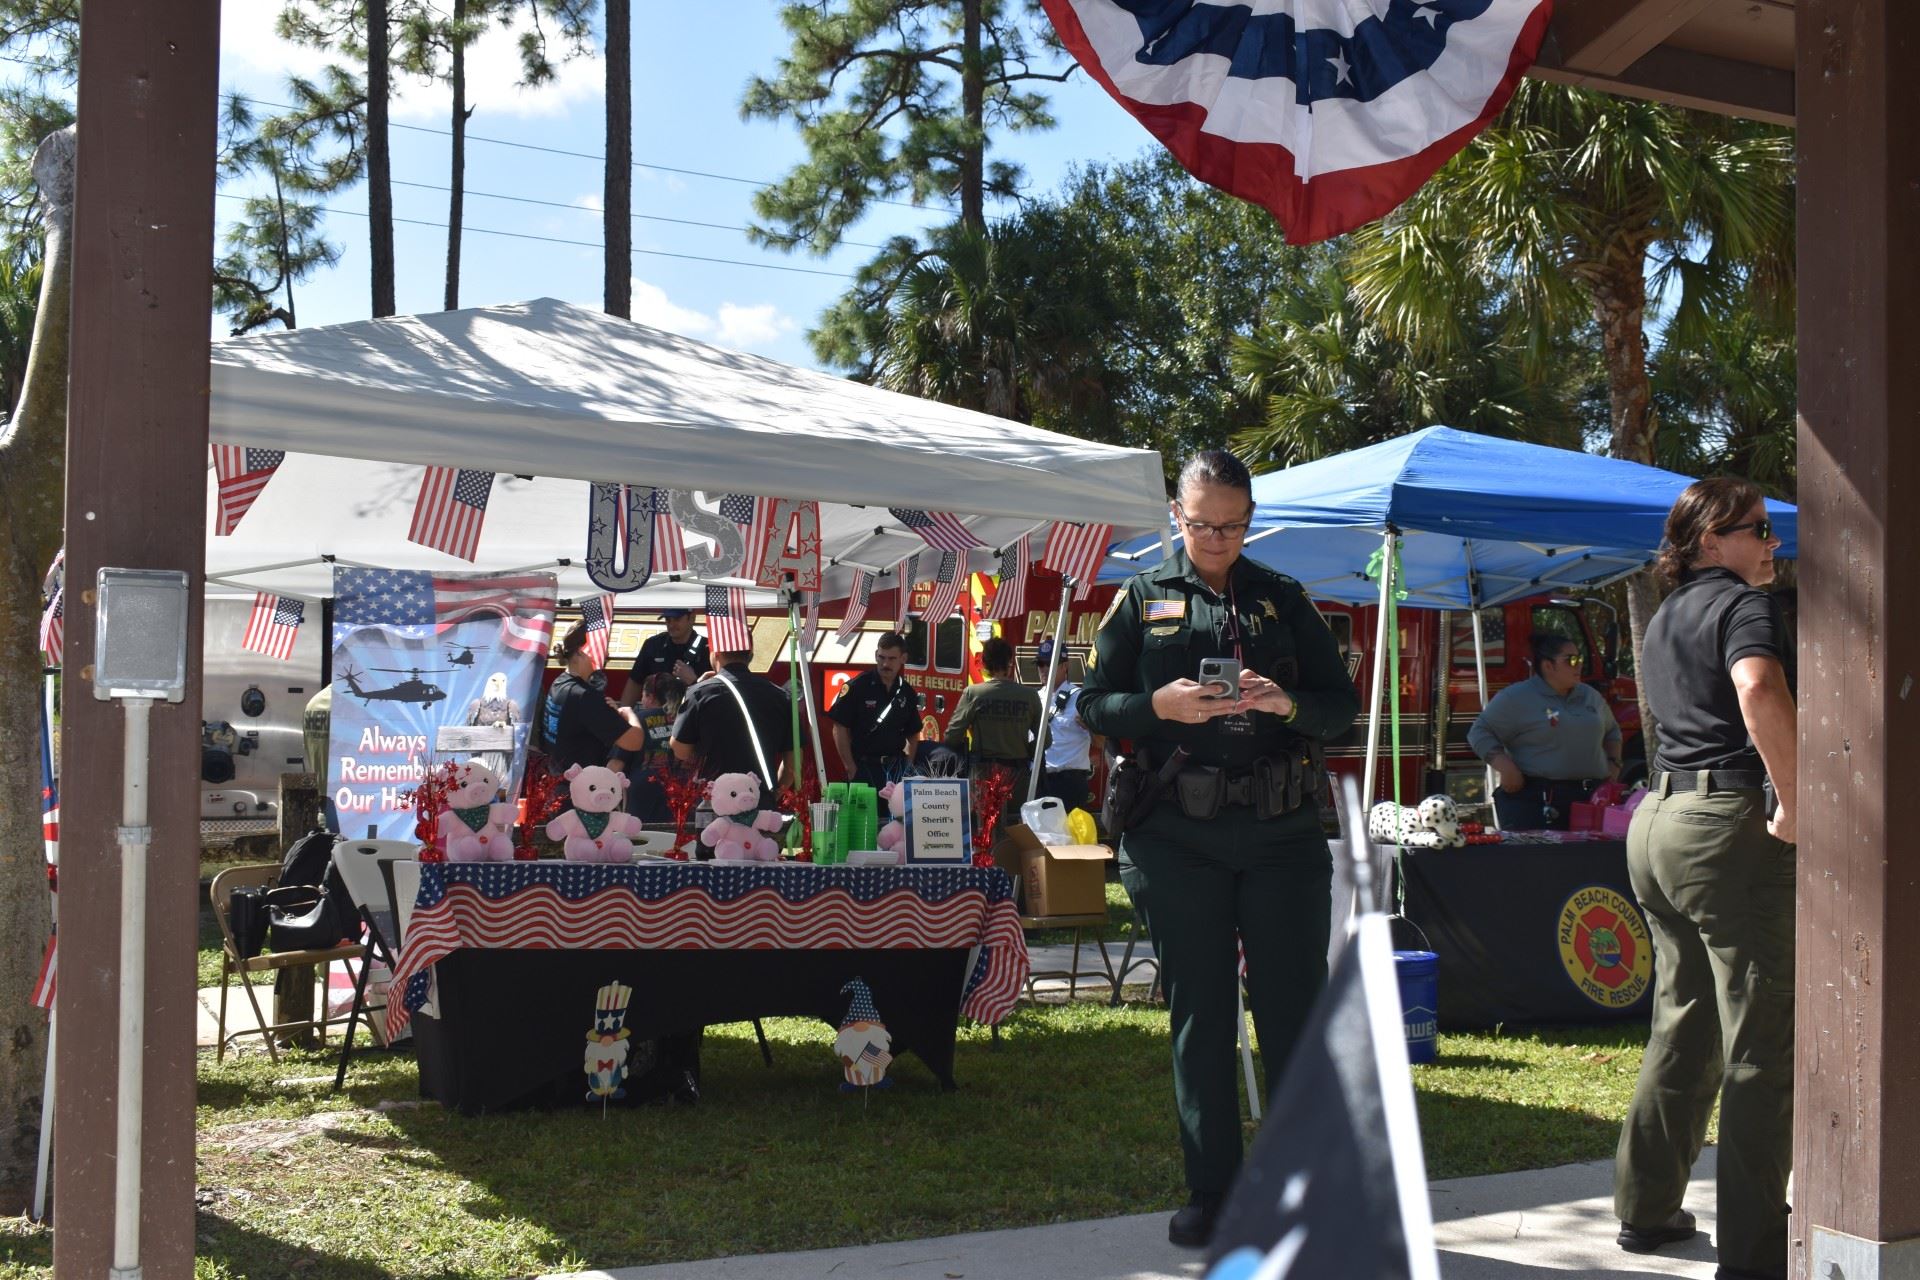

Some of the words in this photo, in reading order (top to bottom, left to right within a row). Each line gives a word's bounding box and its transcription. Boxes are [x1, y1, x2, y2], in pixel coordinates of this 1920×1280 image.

[586, 483, 822, 593] USA
[1024, 610, 1100, 645] PALM
[924, 676, 964, 692] RESCUE
[978, 699, 1029, 716] SHERIFF
[358, 725, 428, 761] Always
[335, 786, 374, 812] Our
[913, 788, 933, 796] Palm
[934, 788, 958, 796] Beach
[922, 802, 951, 811] County
[921, 816, 954, 824] Sheriff's
[927, 830, 950, 838] Office
[1561, 908, 1577, 945] PALM
[1574, 889, 1609, 911] BEACH
[1611, 895, 1646, 940] COUNTY
[1581, 977, 1605, 1002] FIRE
[1609, 973, 1646, 1006] RESCUE
